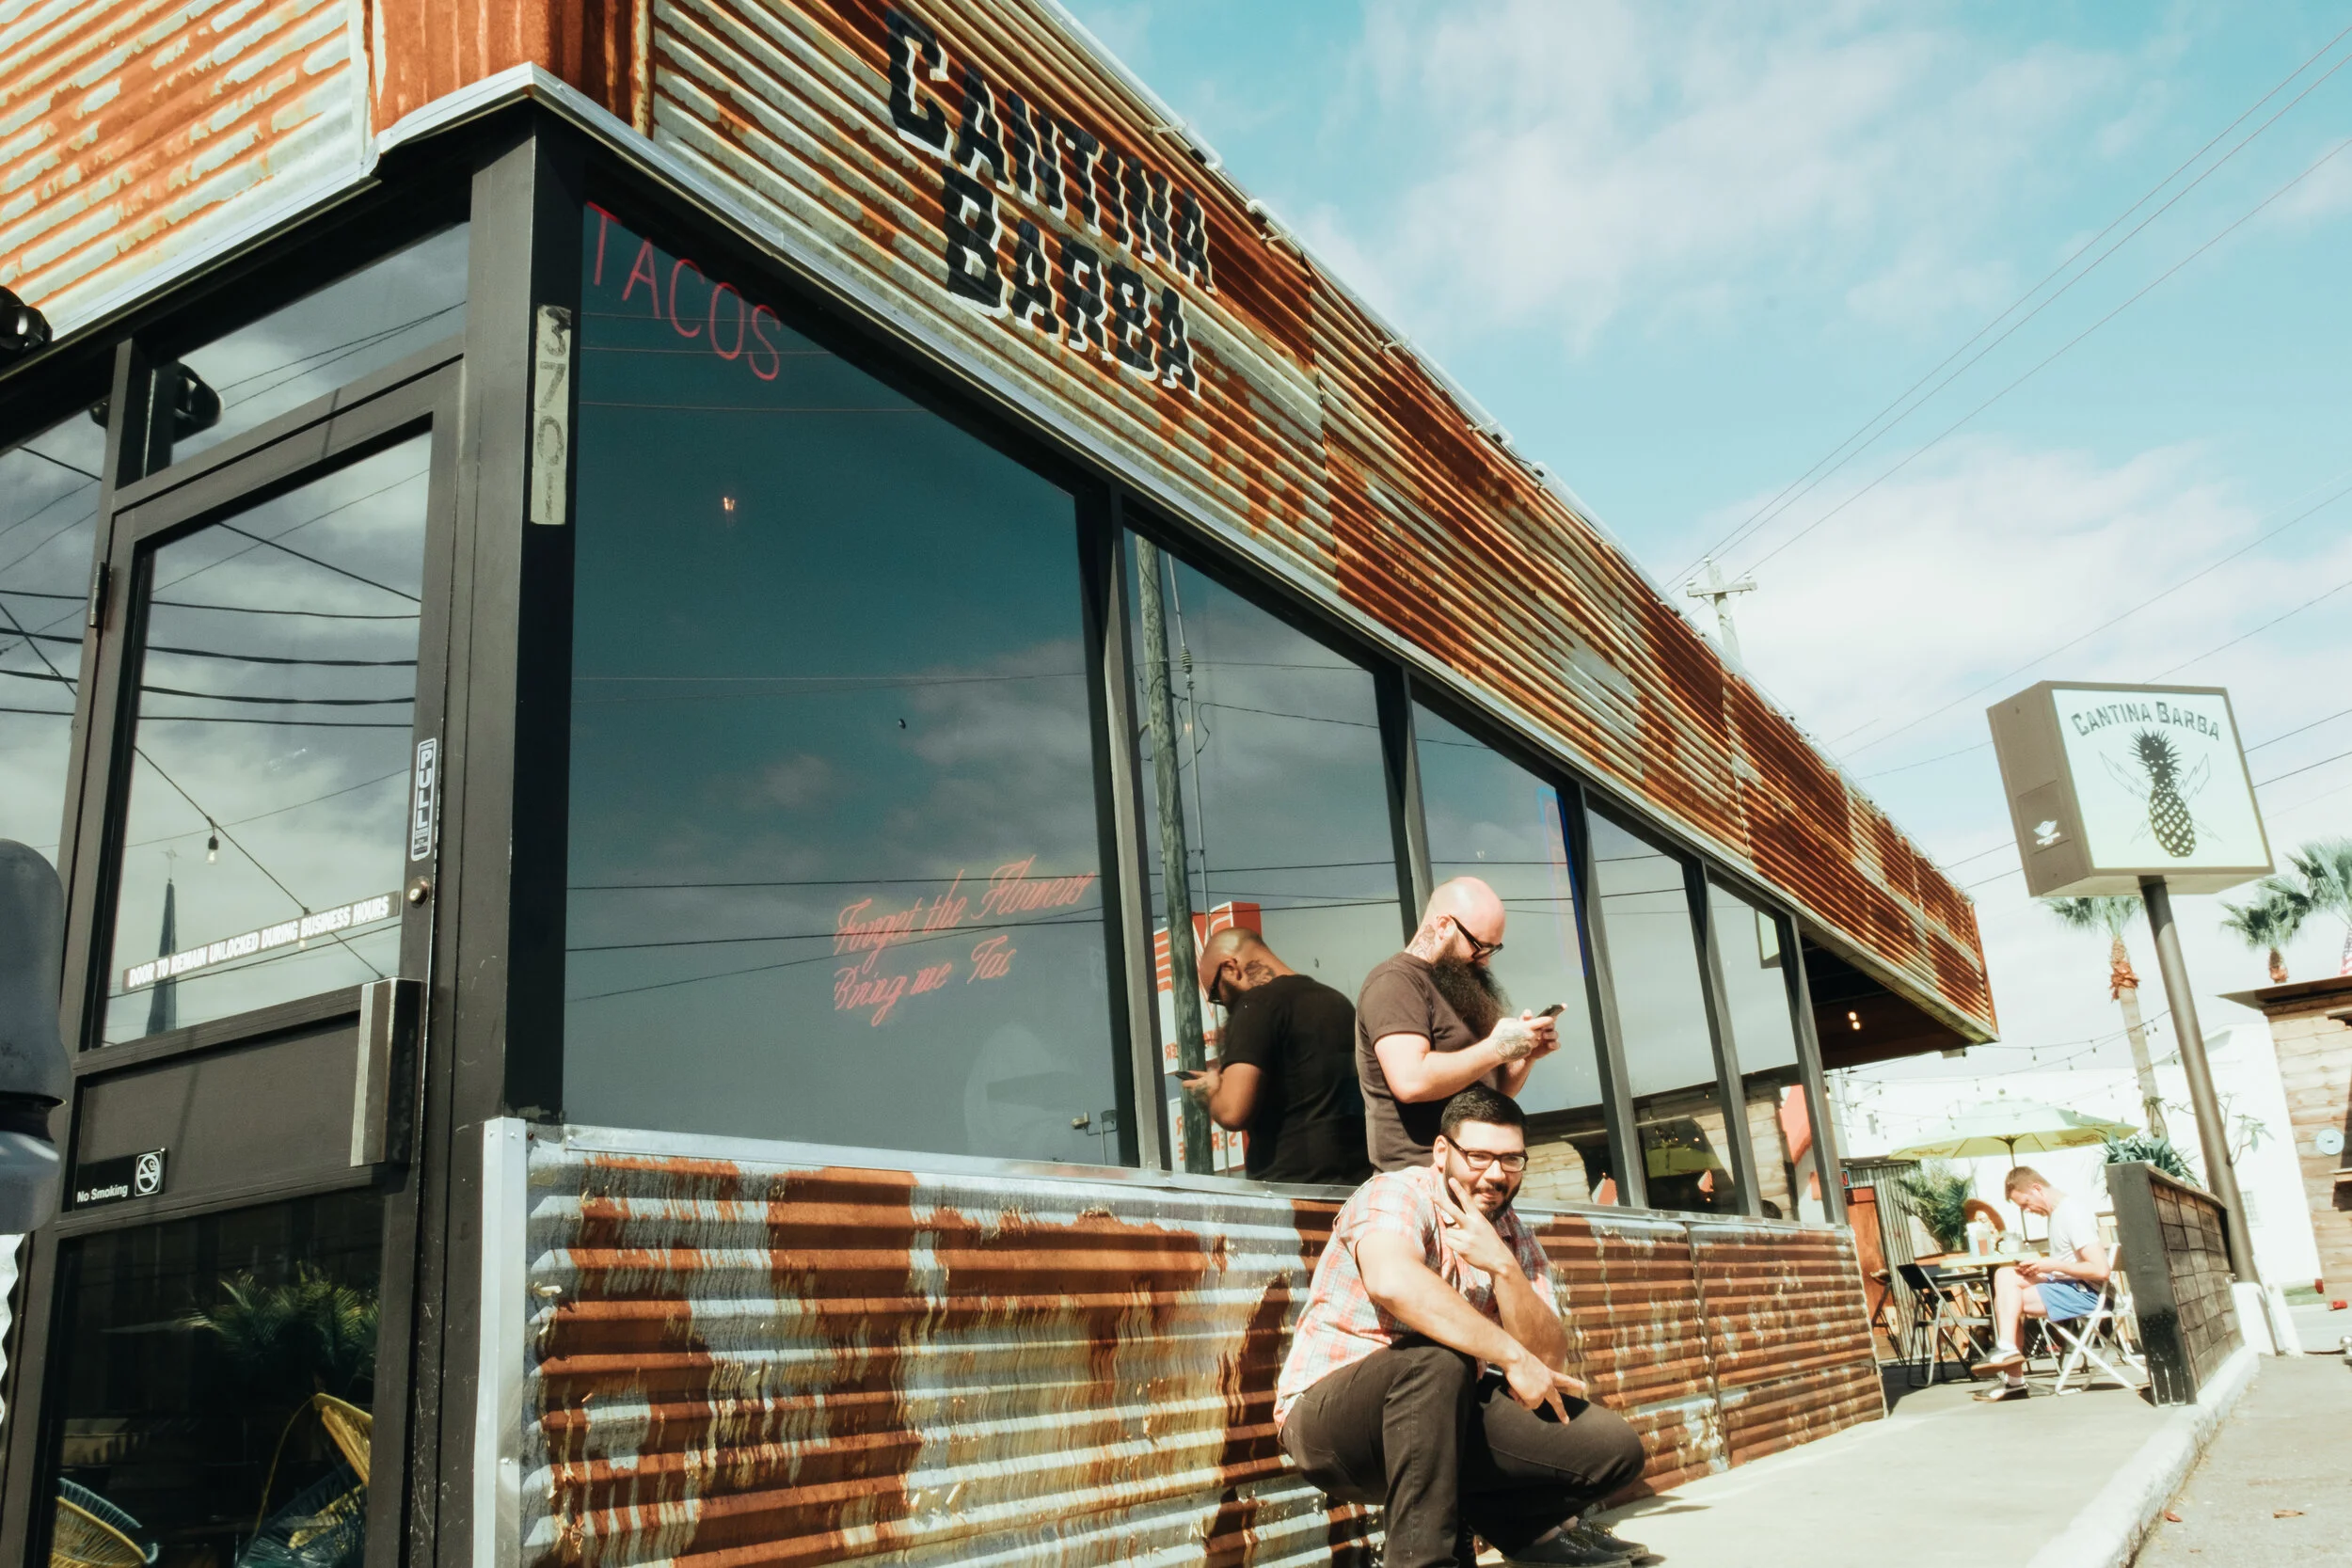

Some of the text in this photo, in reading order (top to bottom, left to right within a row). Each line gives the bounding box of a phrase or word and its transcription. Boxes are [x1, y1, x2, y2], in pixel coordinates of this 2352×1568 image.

[886, 8, 1217, 295] CANTINA
[584, 200, 782, 382] TACOS
[942, 166, 1201, 401] BARBA
[2071, 701, 2219, 741] CANTINA BARBA
[416, 749, 433, 831] PULL
[129, 895, 389, 988] DOOR TO REMAIN UNLOCKED DURING BUSINESS HOURS
[834, 854, 1095, 974] Forget the Flowers
[834, 965, 907, 1027] Bring
[910, 962, 952, 995] me
[76, 1183, 129, 1203] No Smoking
